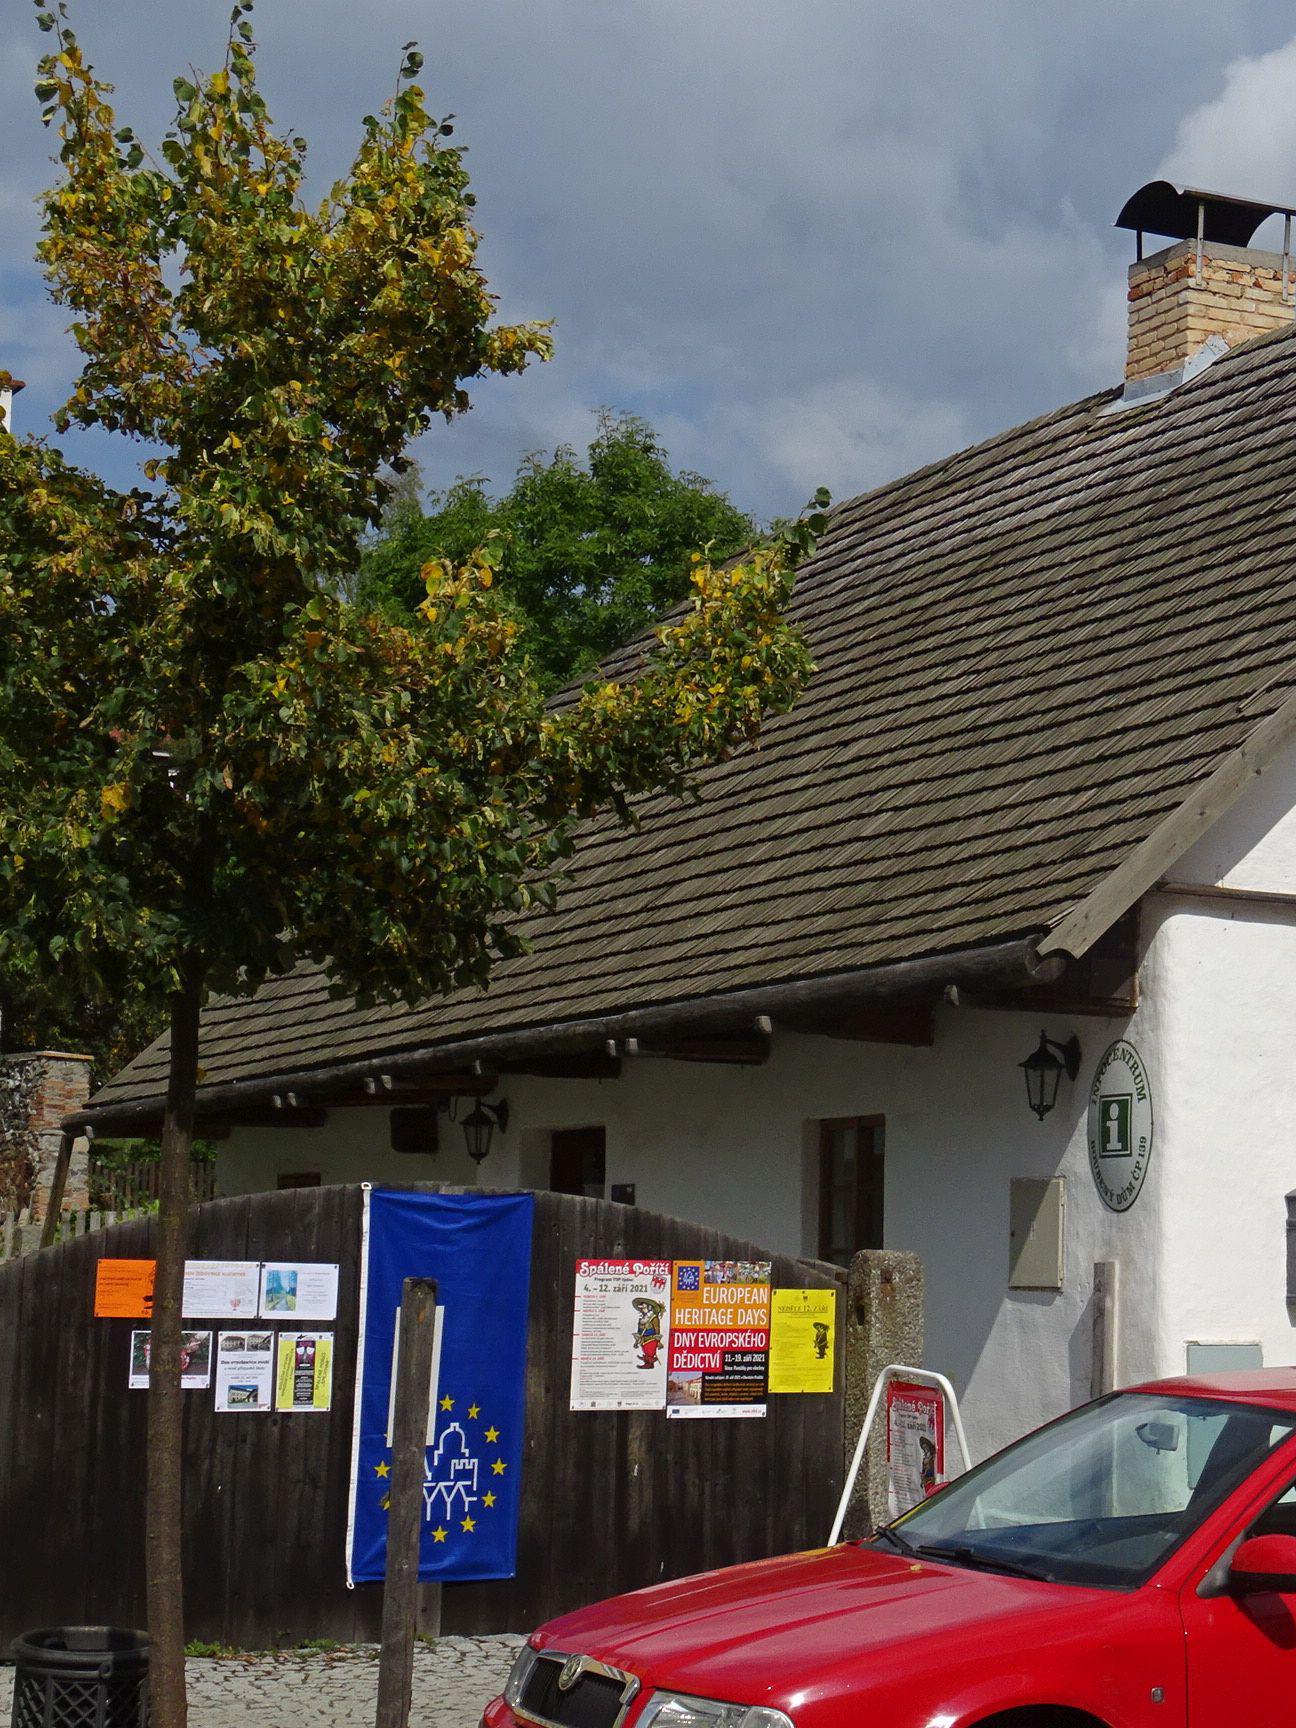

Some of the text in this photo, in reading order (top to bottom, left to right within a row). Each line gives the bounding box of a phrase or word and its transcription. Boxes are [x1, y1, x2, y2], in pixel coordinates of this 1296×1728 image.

[1137, 1135, 1147, 1159] 139
[579, 1261, 670, 1277] Spálené Poříčí
[583, 1283, 591, 1292] 4.
[599, 1284, 611, 1292] 12.
[613, 1284, 628, 1292] září
[630, 1284, 648, 1292] 2021
[703, 1287, 768, 1304] EUROPEAN
[675, 1308, 767, 1325] HERITAGE DAYS
[674, 1330, 766, 1348] DNY EVROPSKÉHO
[673, 1350, 720, 1368] DĚDICTVÍ
[752, 1354, 765, 1362] 2021
